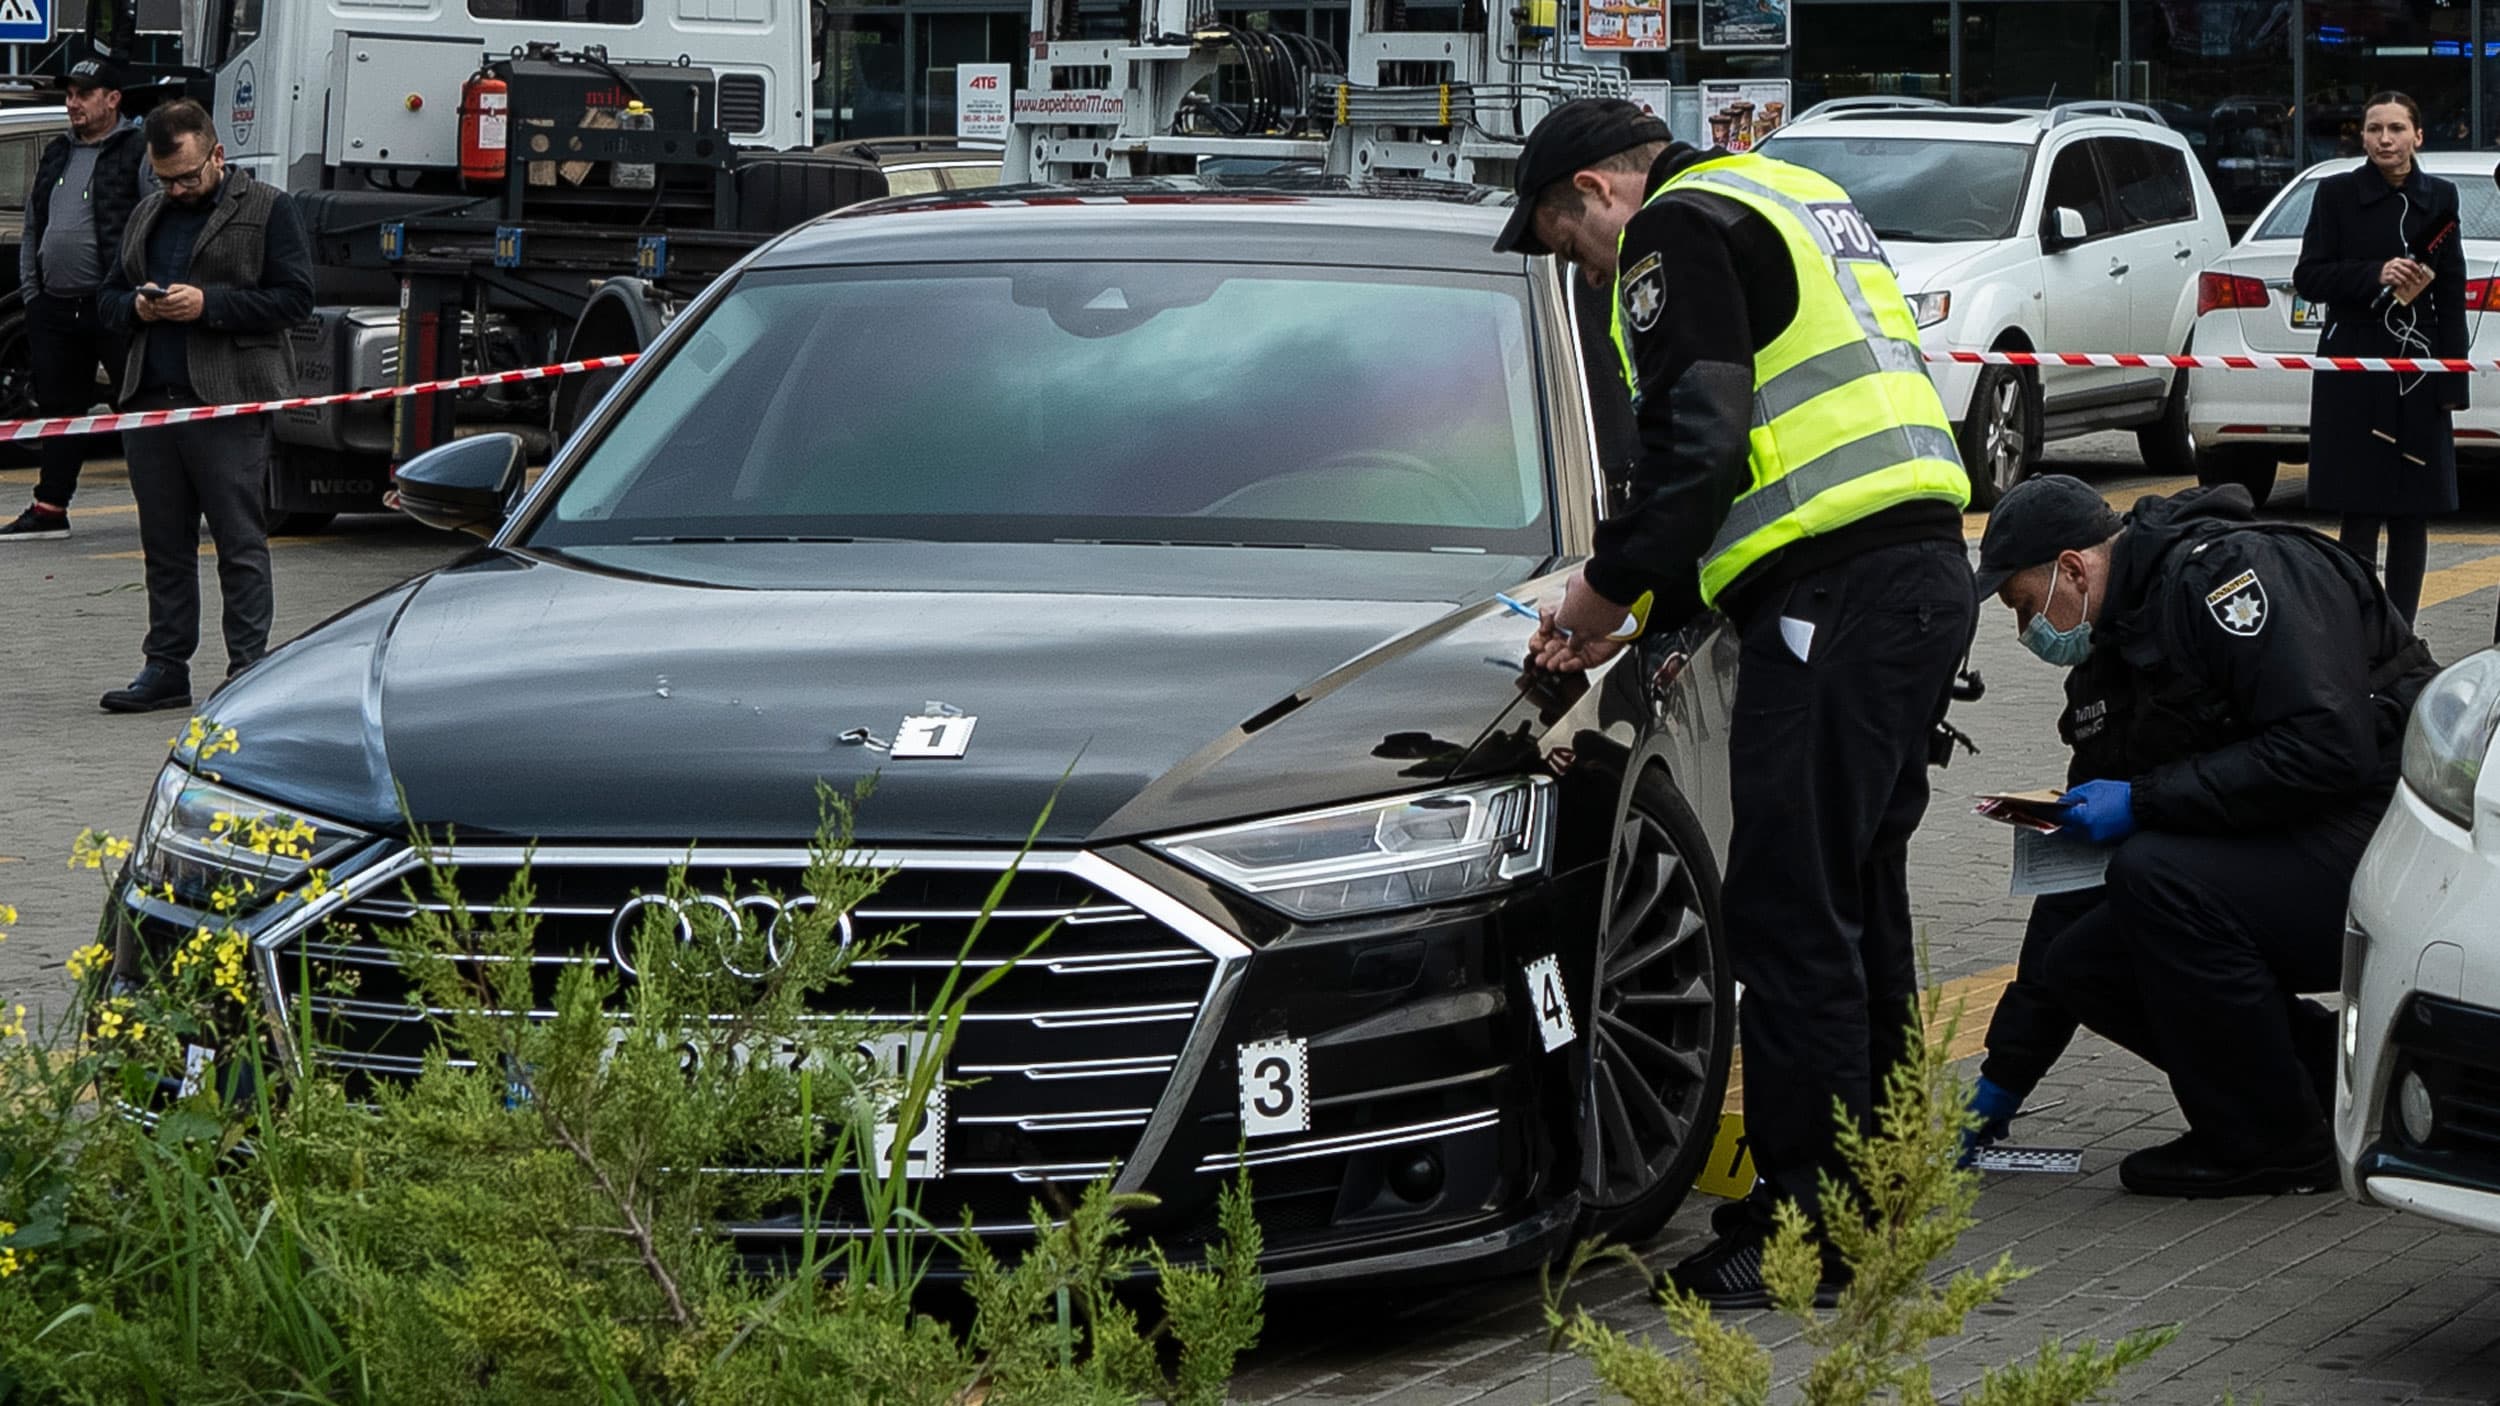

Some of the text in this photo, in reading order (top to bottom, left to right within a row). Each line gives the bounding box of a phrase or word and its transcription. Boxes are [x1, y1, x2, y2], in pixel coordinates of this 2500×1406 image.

[1014, 93, 1124, 116] www.expedition777.com
[310, 479, 375, 495] IVECO
[919, 724, 948, 748] 1
[1541, 972, 1564, 1031] 4
[1252, 1056, 1296, 1118] 3
